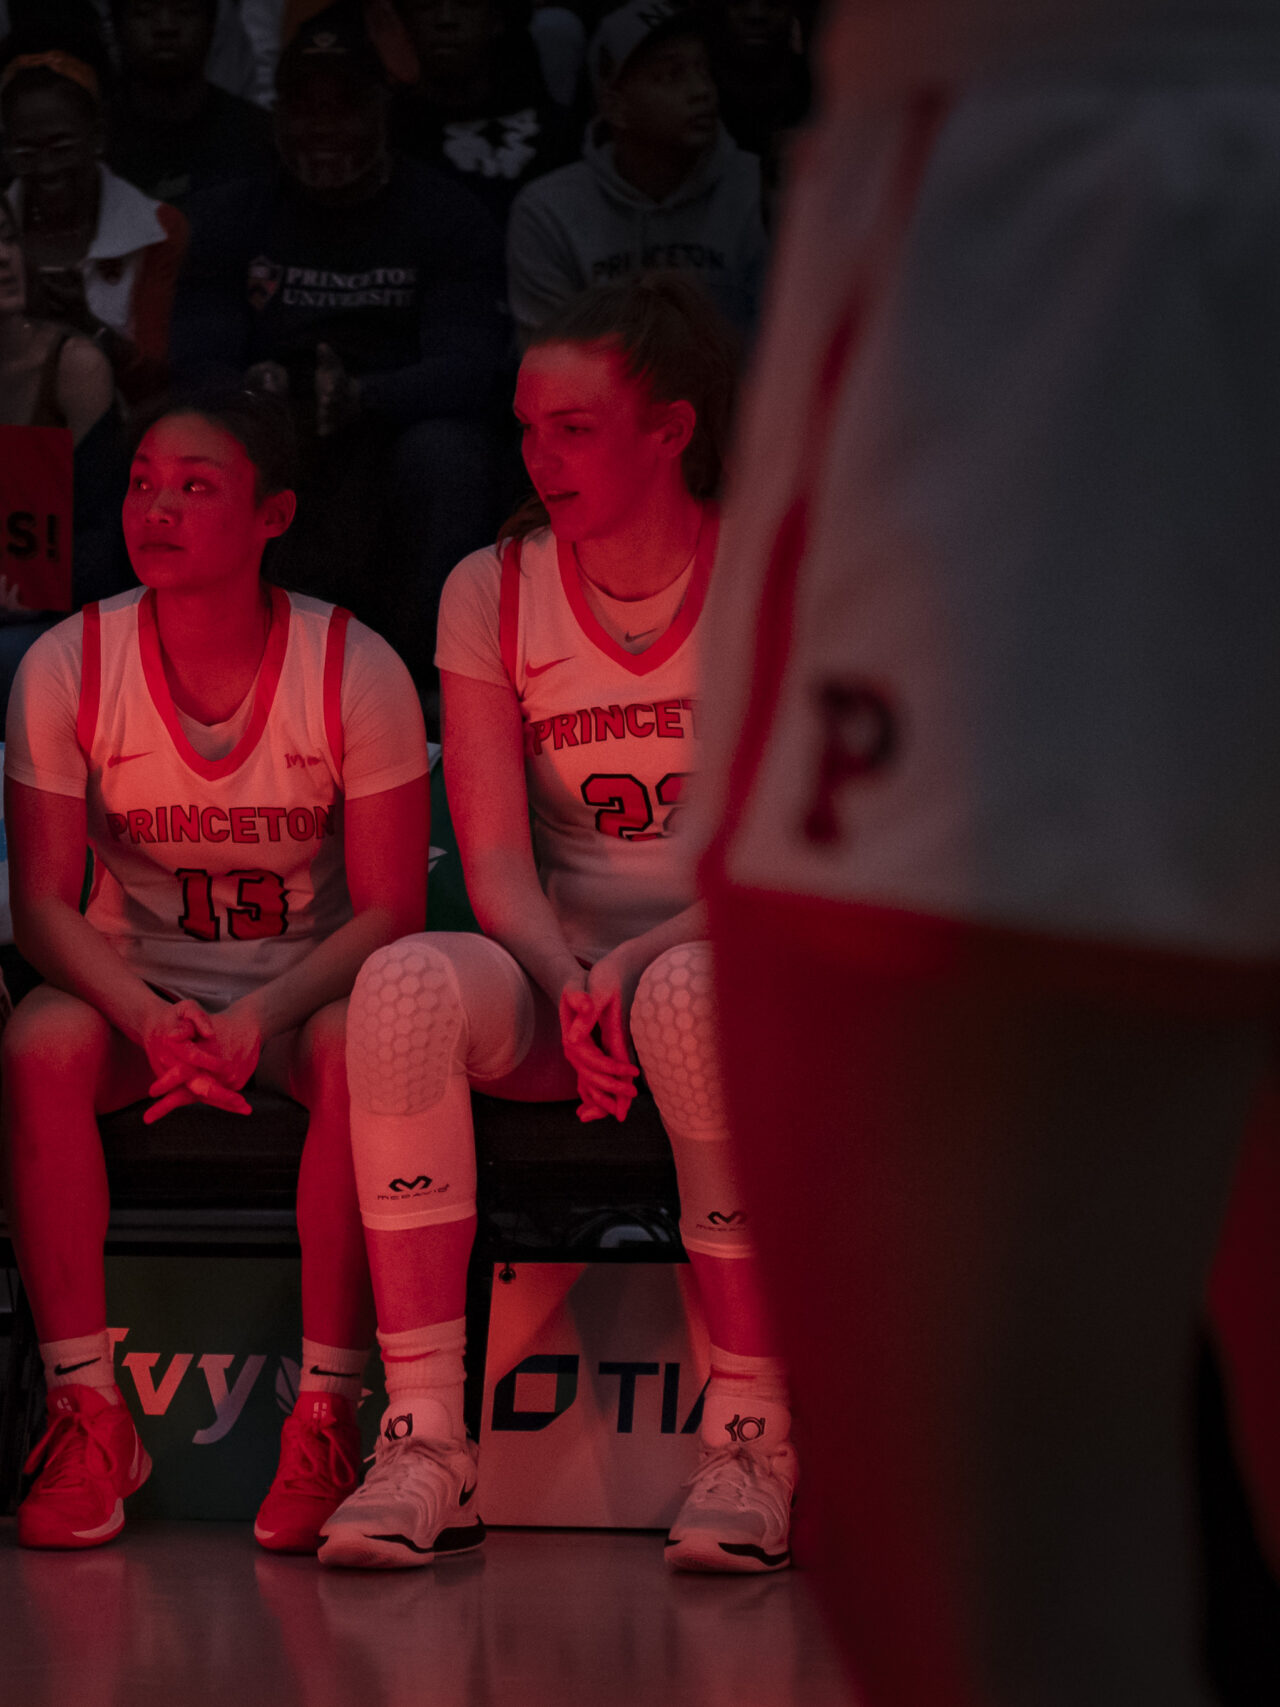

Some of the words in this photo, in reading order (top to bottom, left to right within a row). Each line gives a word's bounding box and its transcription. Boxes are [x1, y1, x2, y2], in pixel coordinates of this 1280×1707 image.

[526, 699, 692, 756] PRINCE
[802, 678, 895, 845] P
[106, 805, 336, 844] PRINCETON
[175, 868, 290, 941] 13
